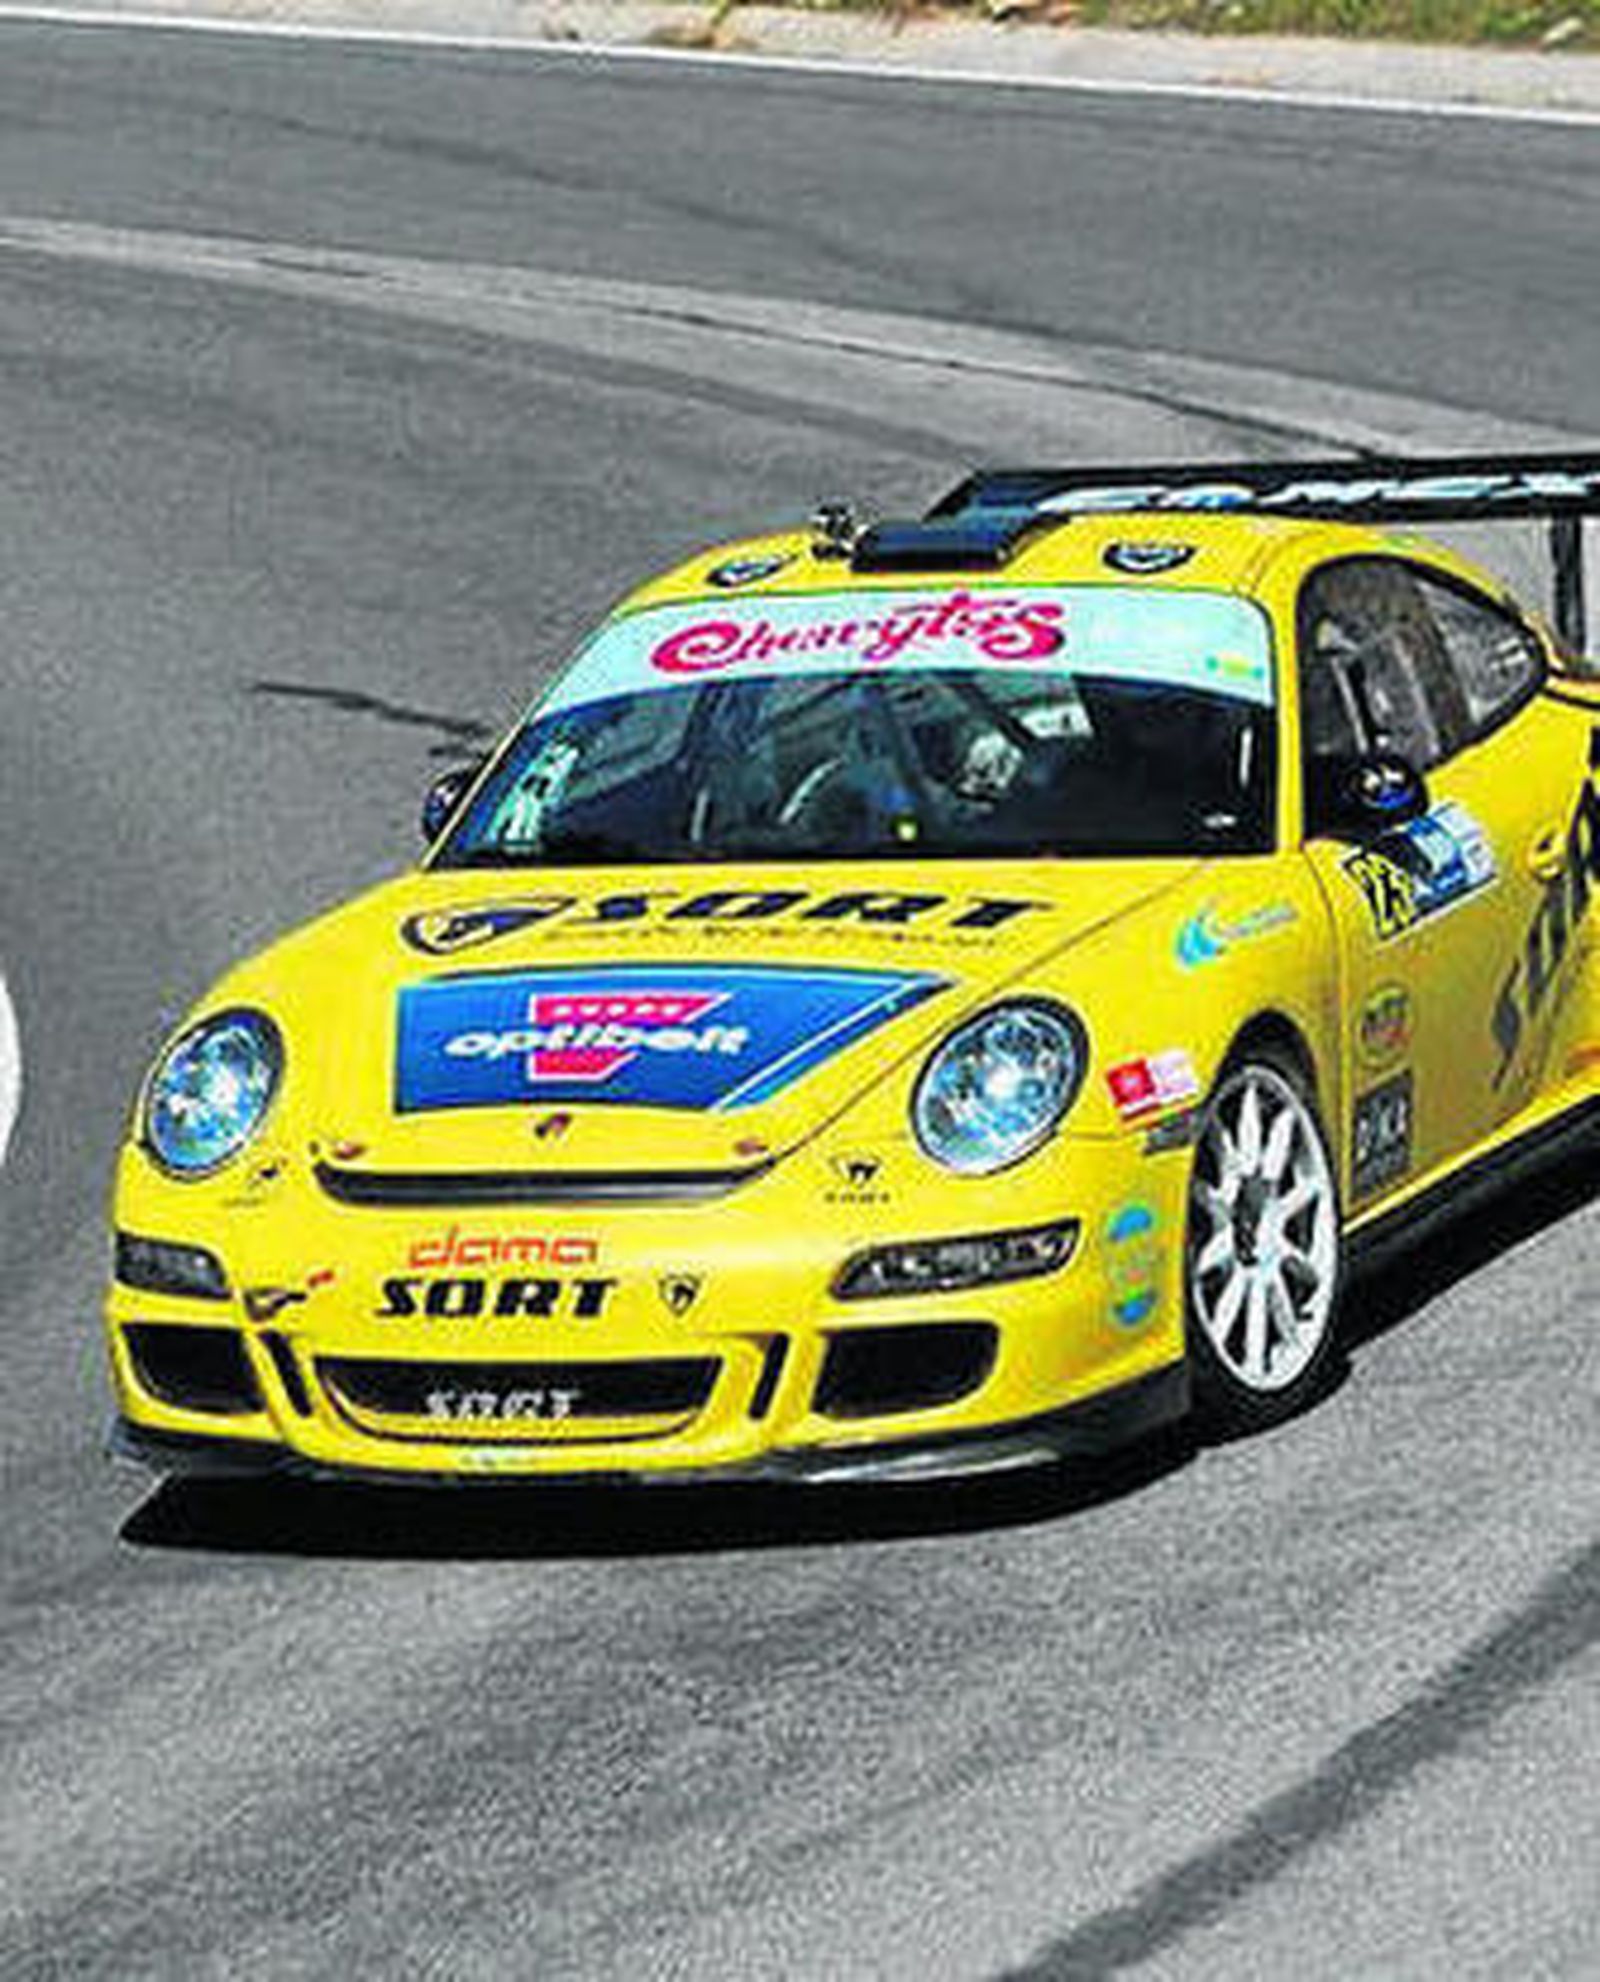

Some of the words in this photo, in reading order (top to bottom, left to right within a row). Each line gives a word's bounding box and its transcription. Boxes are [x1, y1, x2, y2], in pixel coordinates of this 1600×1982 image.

[562, 888, 1053, 930] SORT
[407, 1224, 599, 1269] dama
[374, 1277, 617, 1319] SORT
